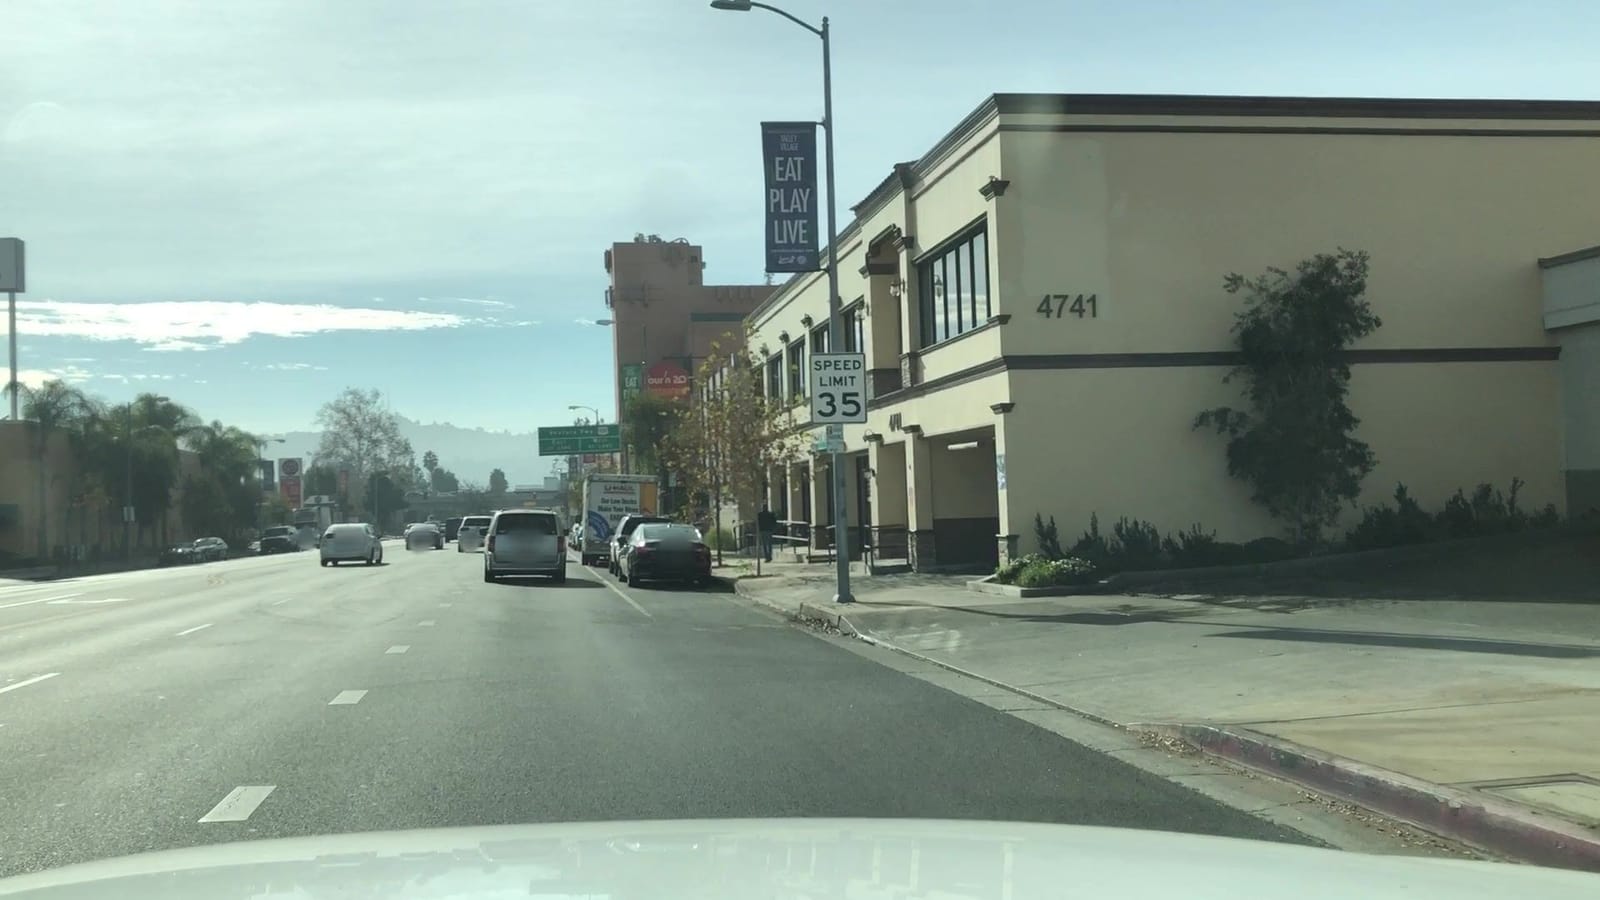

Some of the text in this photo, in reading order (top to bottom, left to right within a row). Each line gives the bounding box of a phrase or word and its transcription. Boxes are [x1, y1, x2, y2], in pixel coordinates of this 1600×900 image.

[775, 156, 805, 182] EAT
[769, 187, 811, 213] PLAY
[774, 219, 809, 244] LIVE
[1036, 293, 1097, 319] 4741
[814, 359, 862, 371] SPEED
[819, 375, 857, 387] LIMIT
[817, 391, 862, 418] 35
